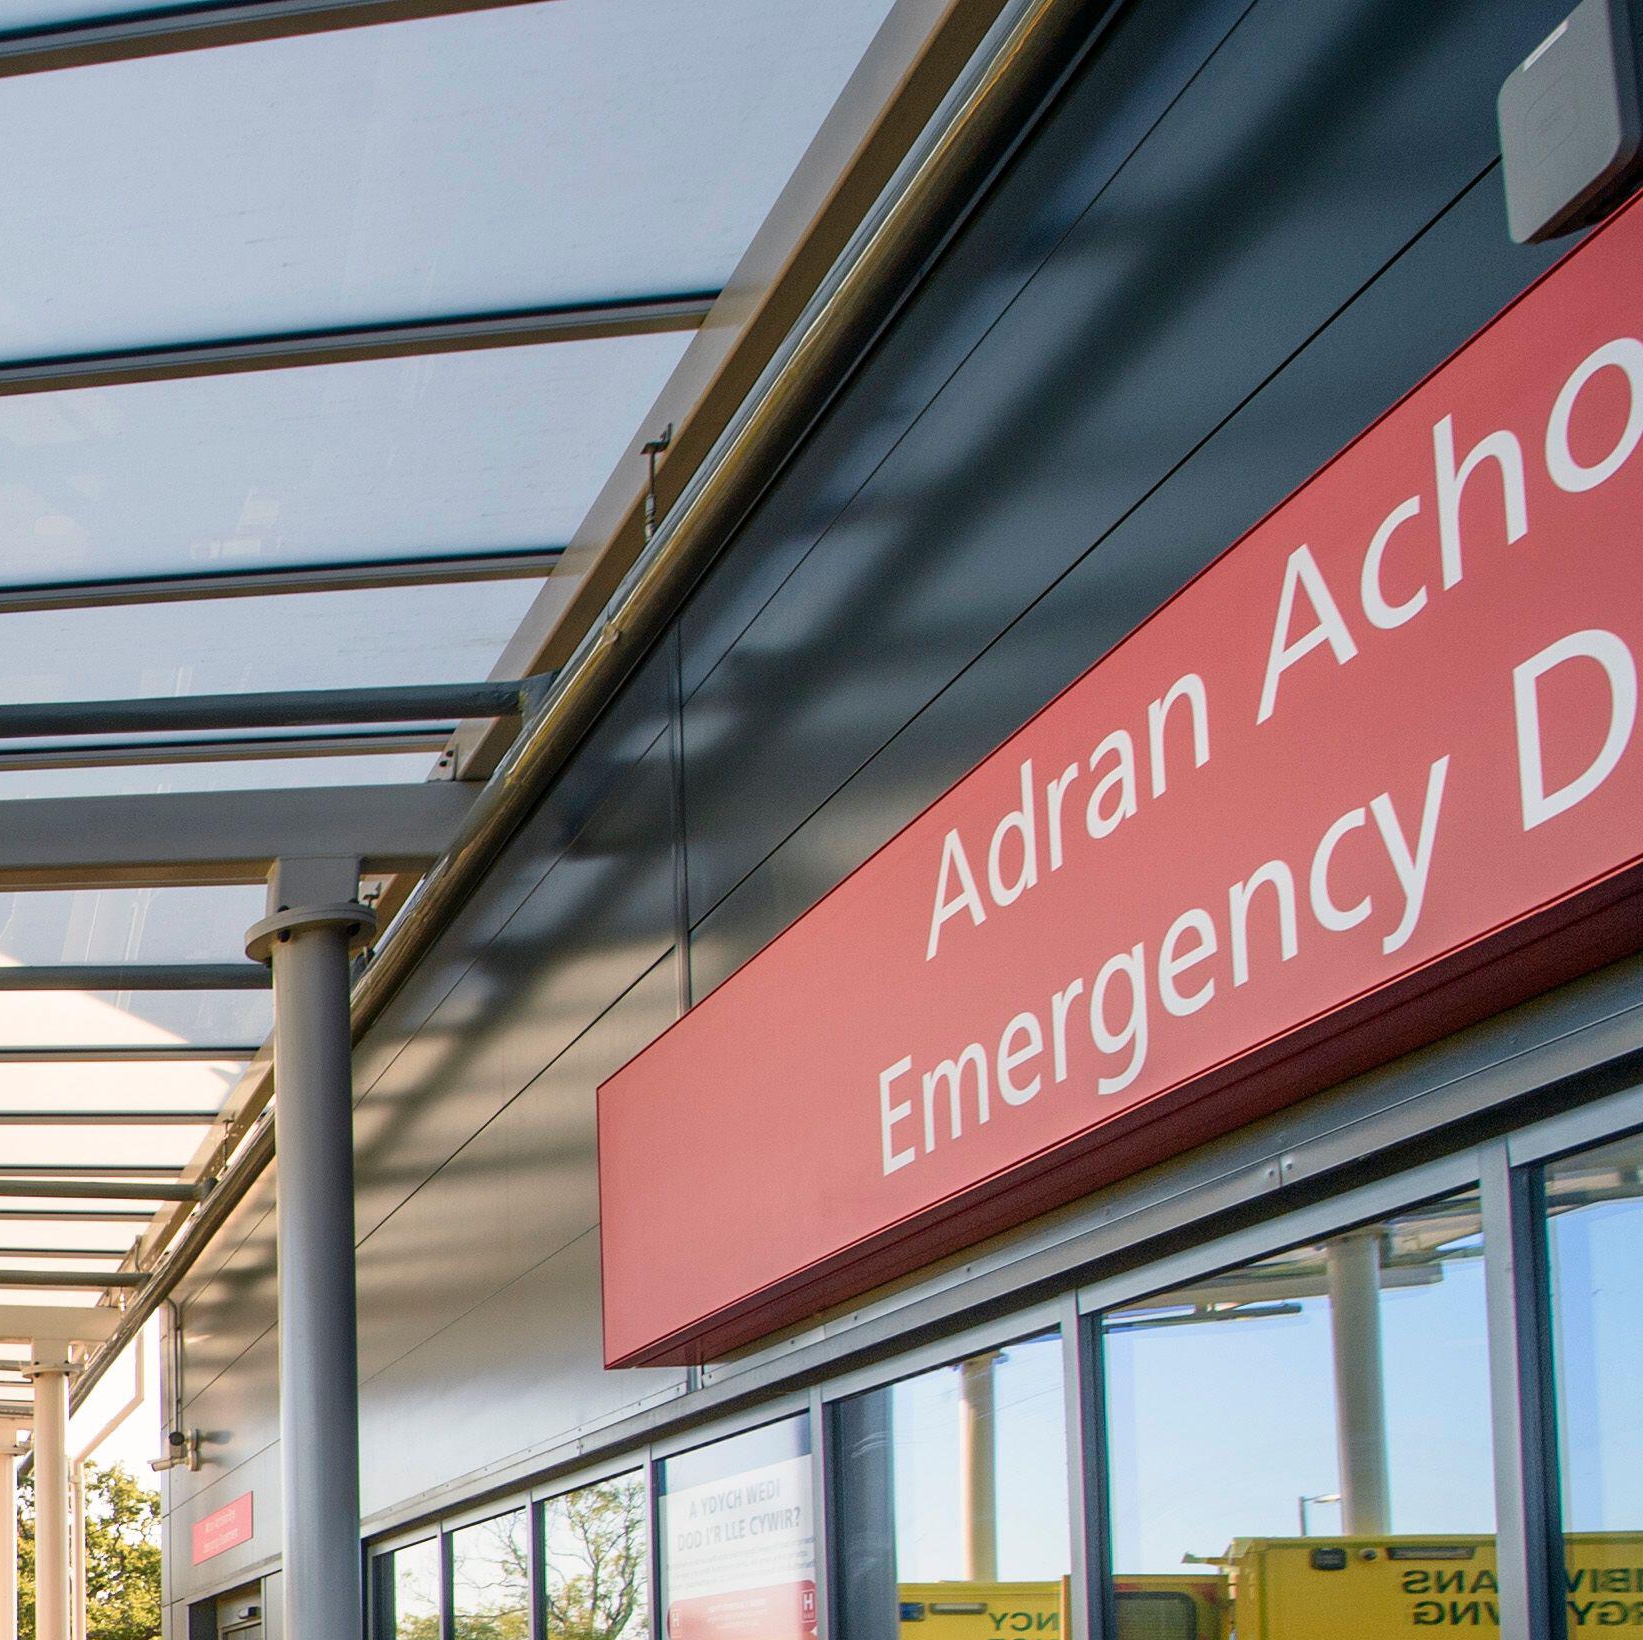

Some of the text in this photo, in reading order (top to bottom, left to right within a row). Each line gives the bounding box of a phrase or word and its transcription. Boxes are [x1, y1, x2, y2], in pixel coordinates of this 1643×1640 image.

[925, 337, 1643, 962] Adran Acho
[878, 629, 1638, 1177] Emergency D
[677, 1529, 703, 1551] DOD
[725, 1519, 746, 1542] LLE
[749, 1506, 801, 1536] CYWIR?
[701, 1489, 743, 1517] YDYCH
[746, 1478, 780, 1505] WEDI
